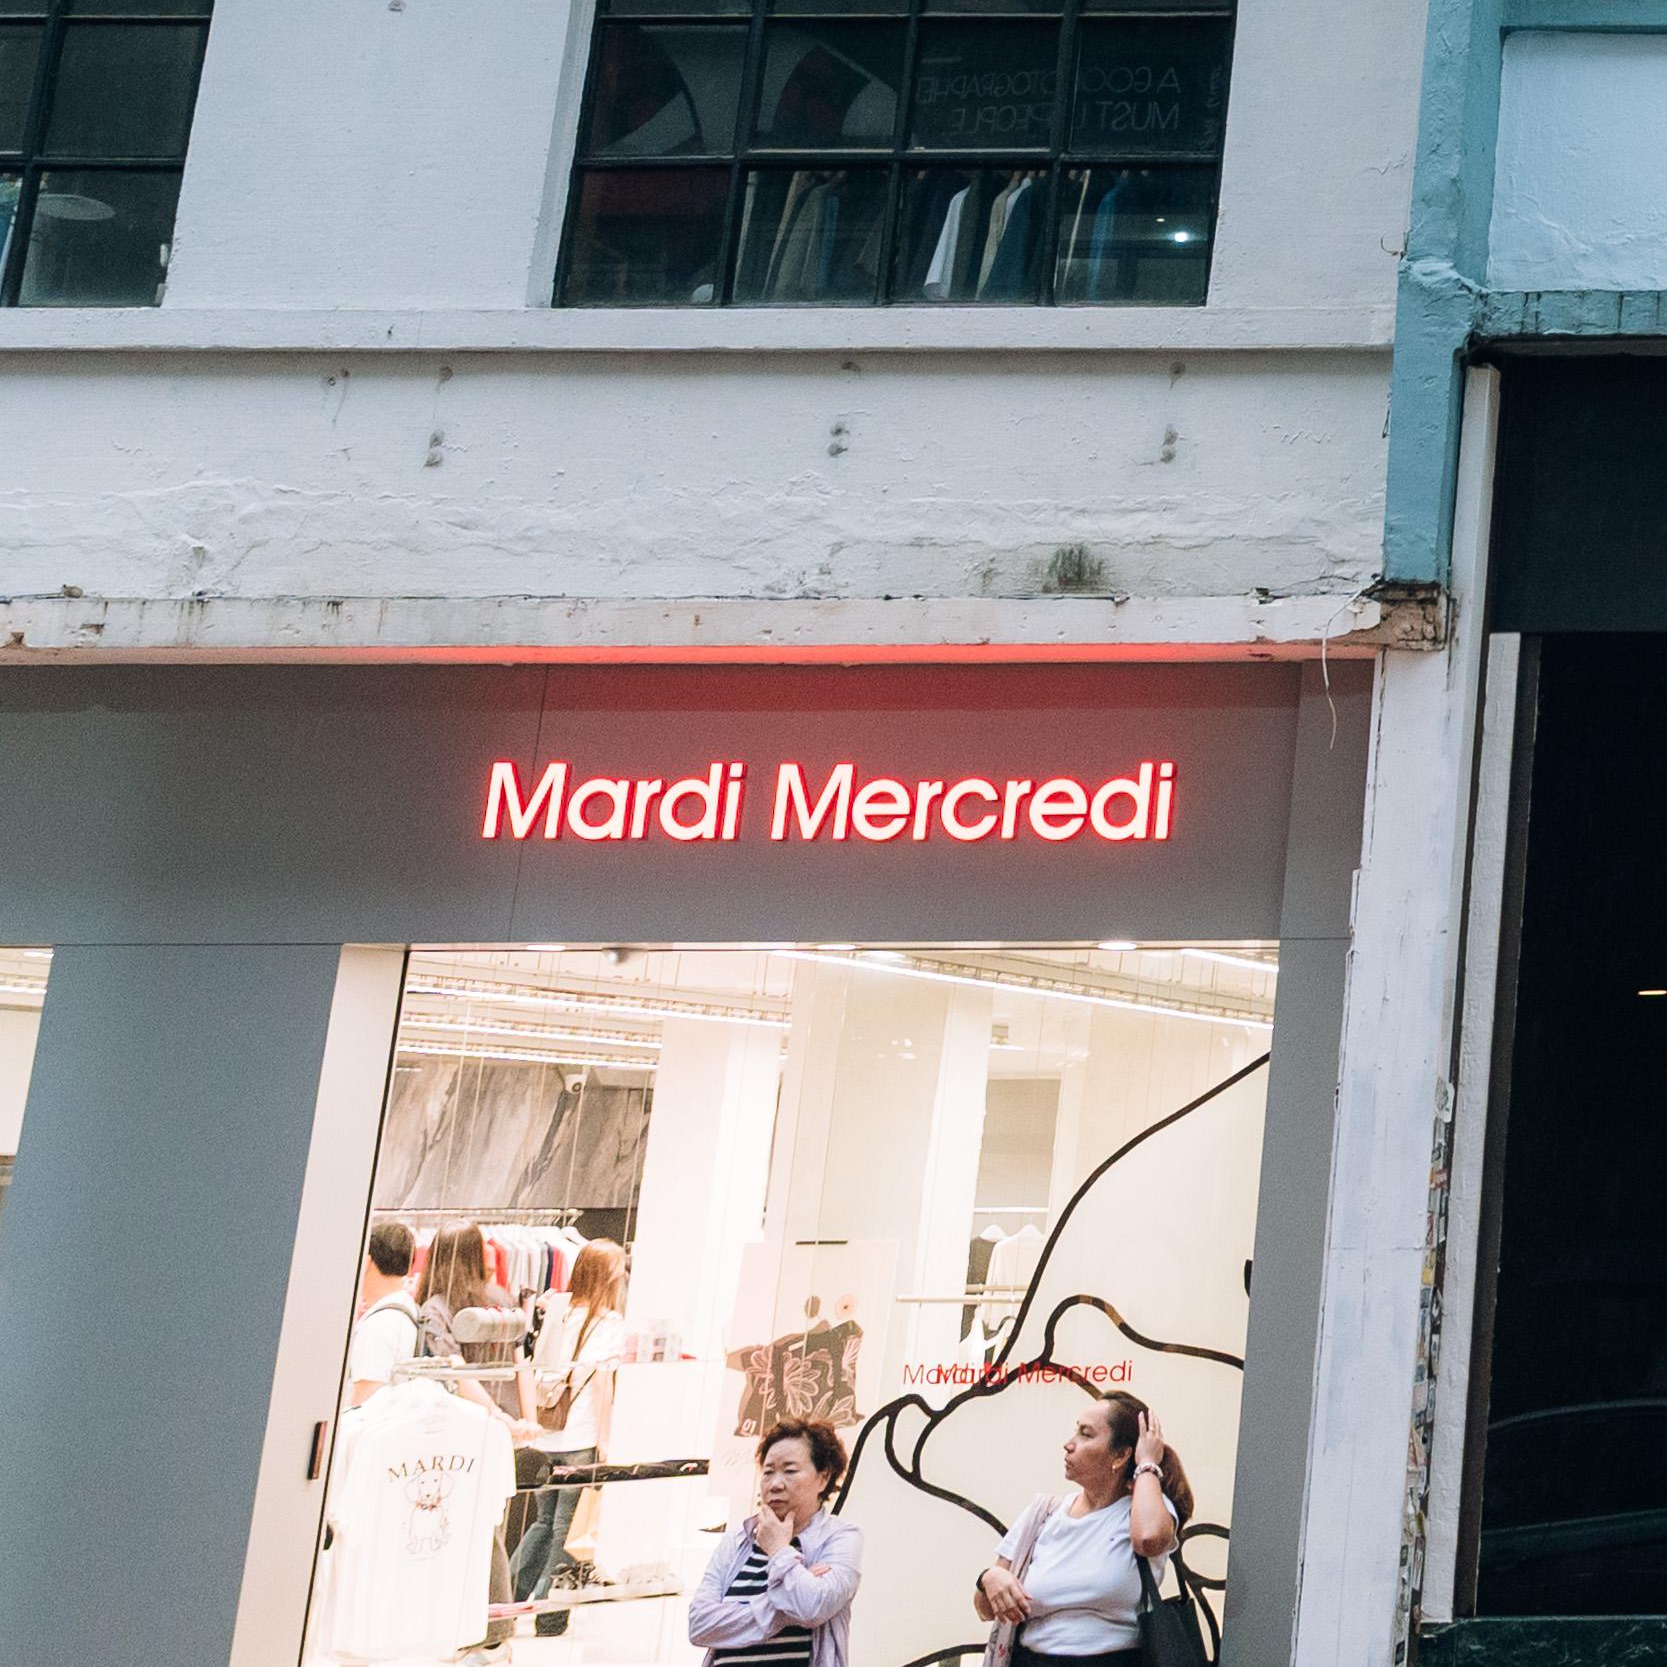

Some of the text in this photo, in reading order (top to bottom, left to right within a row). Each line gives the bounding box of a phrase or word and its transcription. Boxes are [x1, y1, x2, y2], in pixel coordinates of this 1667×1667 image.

[480, 761, 1175, 842] Mardi Mercredi
[1017, 1359, 1134, 1384] Mercredi
[387, 1454, 475, 1483] MARDI
